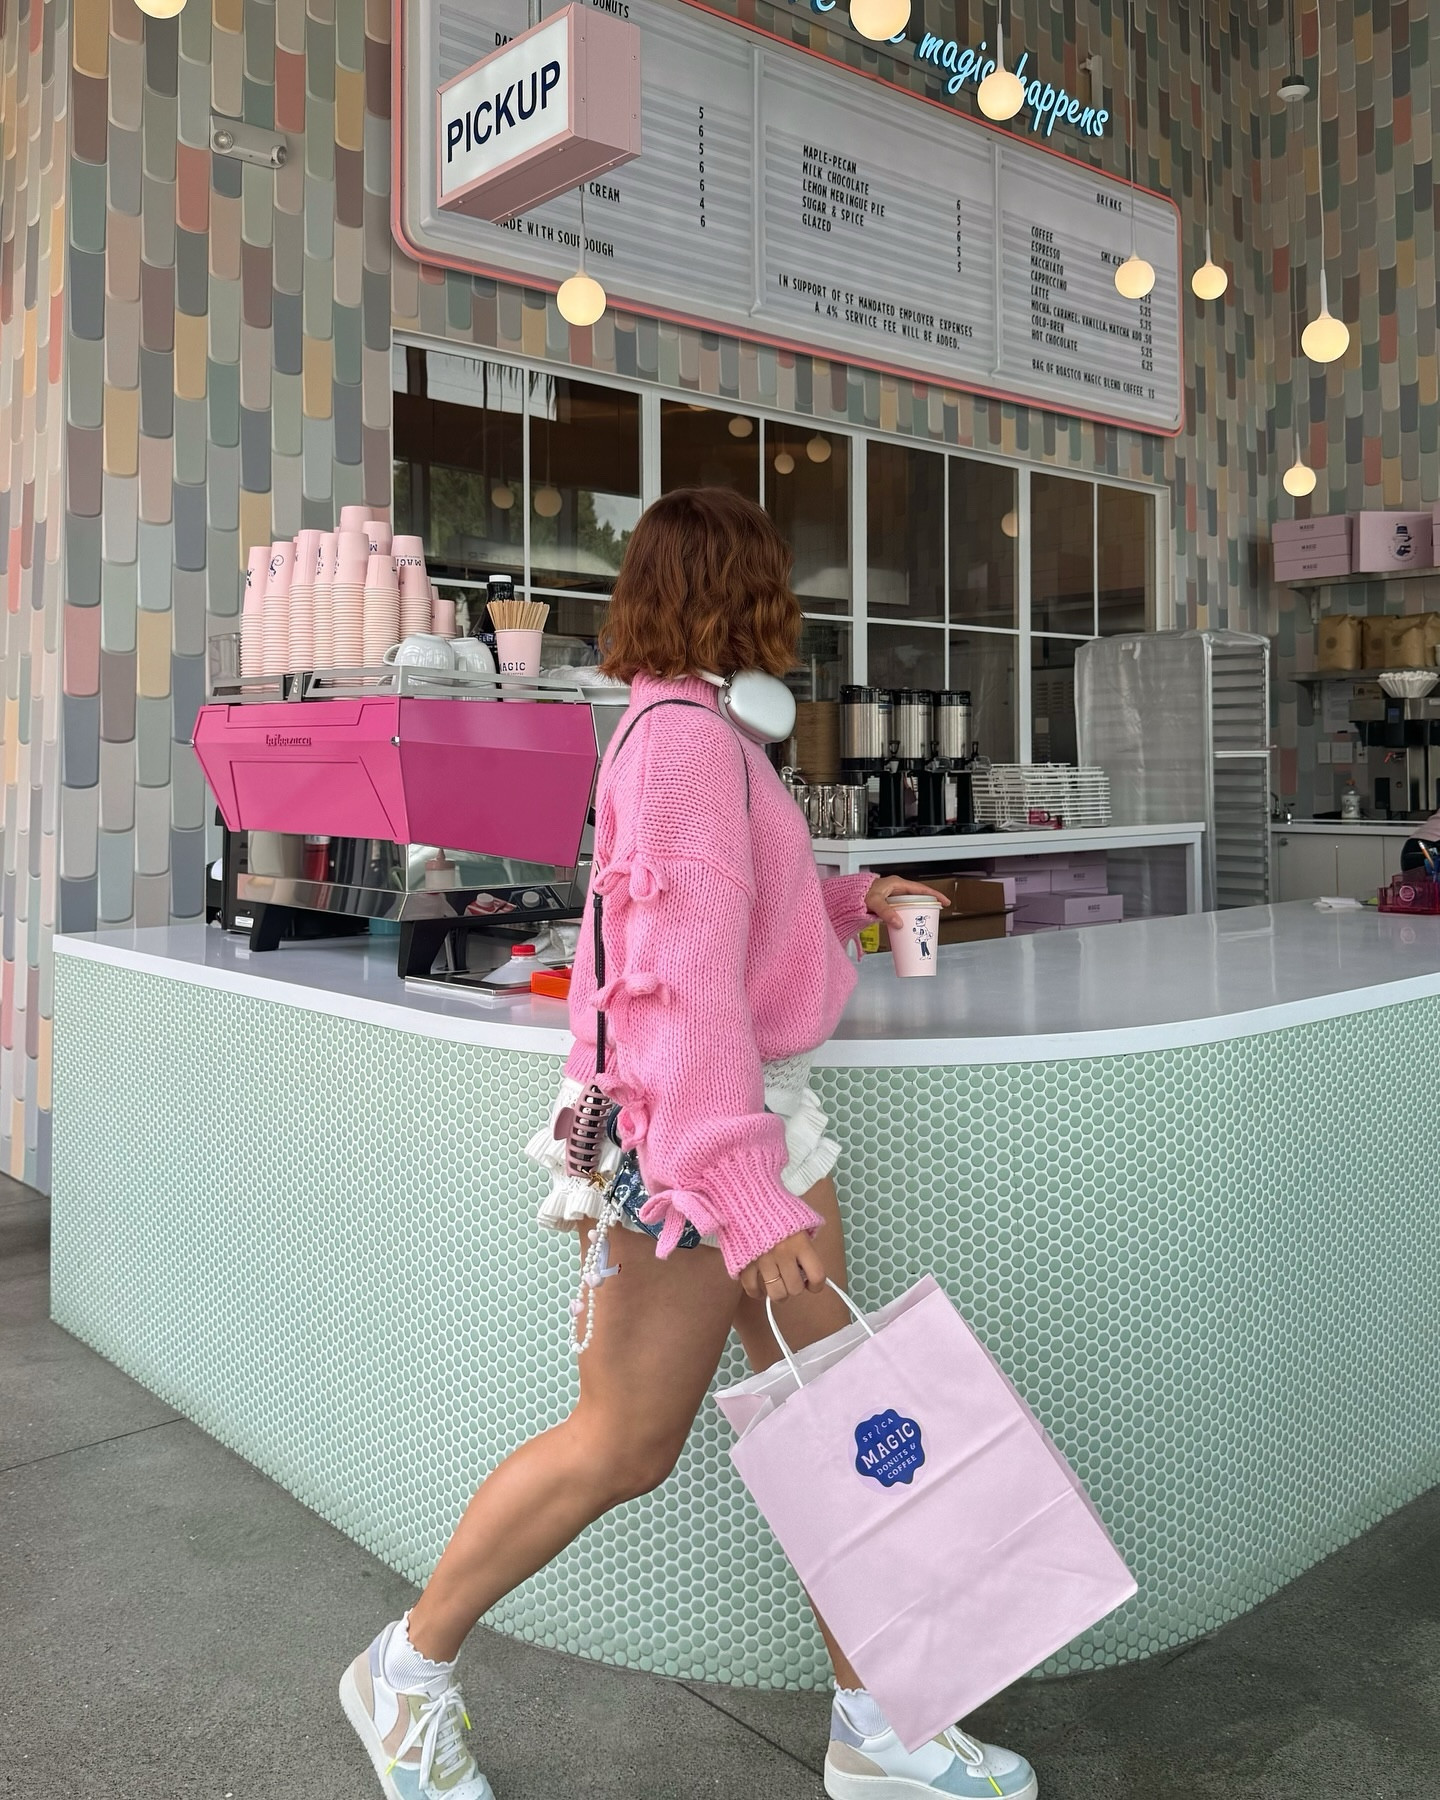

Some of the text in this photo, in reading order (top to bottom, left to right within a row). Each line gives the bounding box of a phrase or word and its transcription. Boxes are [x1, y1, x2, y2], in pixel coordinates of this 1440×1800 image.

[919, 32, 1109, 137] magic happens
[447, 60, 561, 163] PICKUP
[699, 107, 704, 119] 5
[698, 125, 704, 137] 6
[699, 143, 704, 155] 5
[699, 161, 704, 173] 6
[803, 145, 857, 175] MAPLE-PECAN
[699, 180, 705, 192] 6
[803, 162, 869, 195] MILK CHOCOLATE
[589, 182, 620, 203] CREAM
[803, 179, 885, 217] LEMON MERINGUE PIE
[1097, 193, 1122, 212] DRINKS
[699, 197, 705, 210] 4
[802, 196, 864, 226] SUGAR & SPICE
[496, 218, 523, 232] ADE
[527, 221, 554, 241] WITH
[700, 216, 706, 228] 6
[802, 213, 832, 232] GLAZED
[1031, 226, 1053, 243] COFFEE
[1031, 240, 1061, 260] ESPRESSO
[1031, 255, 1064, 276] MACCHIATO
[1031, 270, 1067, 291] CAPPUCCINO
[1031, 284, 1049, 300] LATTE
[779, 273, 788, 287] IN
[793, 278, 827, 298] SUPPORT
[832, 289, 841, 302] OF
[858, 296, 895, 317] MANDATED
[899, 307, 934, 328] EMPLOYER
[939, 318, 973, 338] EXPENSES
[814, 301, 960, 350] A 4% SERVICE FEE WILL BE ADDED.
[1031, 329, 1078, 352] HOT CHOCOLATE
[1032, 358, 1044, 371] BAG
[1046, 362, 1054, 373] OF
[1104, 377, 1121, 391] BLEND
[1123, 382, 1143, 396] COFFEE
[396, 558, 422, 567] MAGI
[862, 1418, 894, 1443] SF CA
[861, 1422, 914, 1470] MAGIC
[876, 1448, 908, 1475] DONUTS
[887, 1454, 917, 1479] COFFEE
